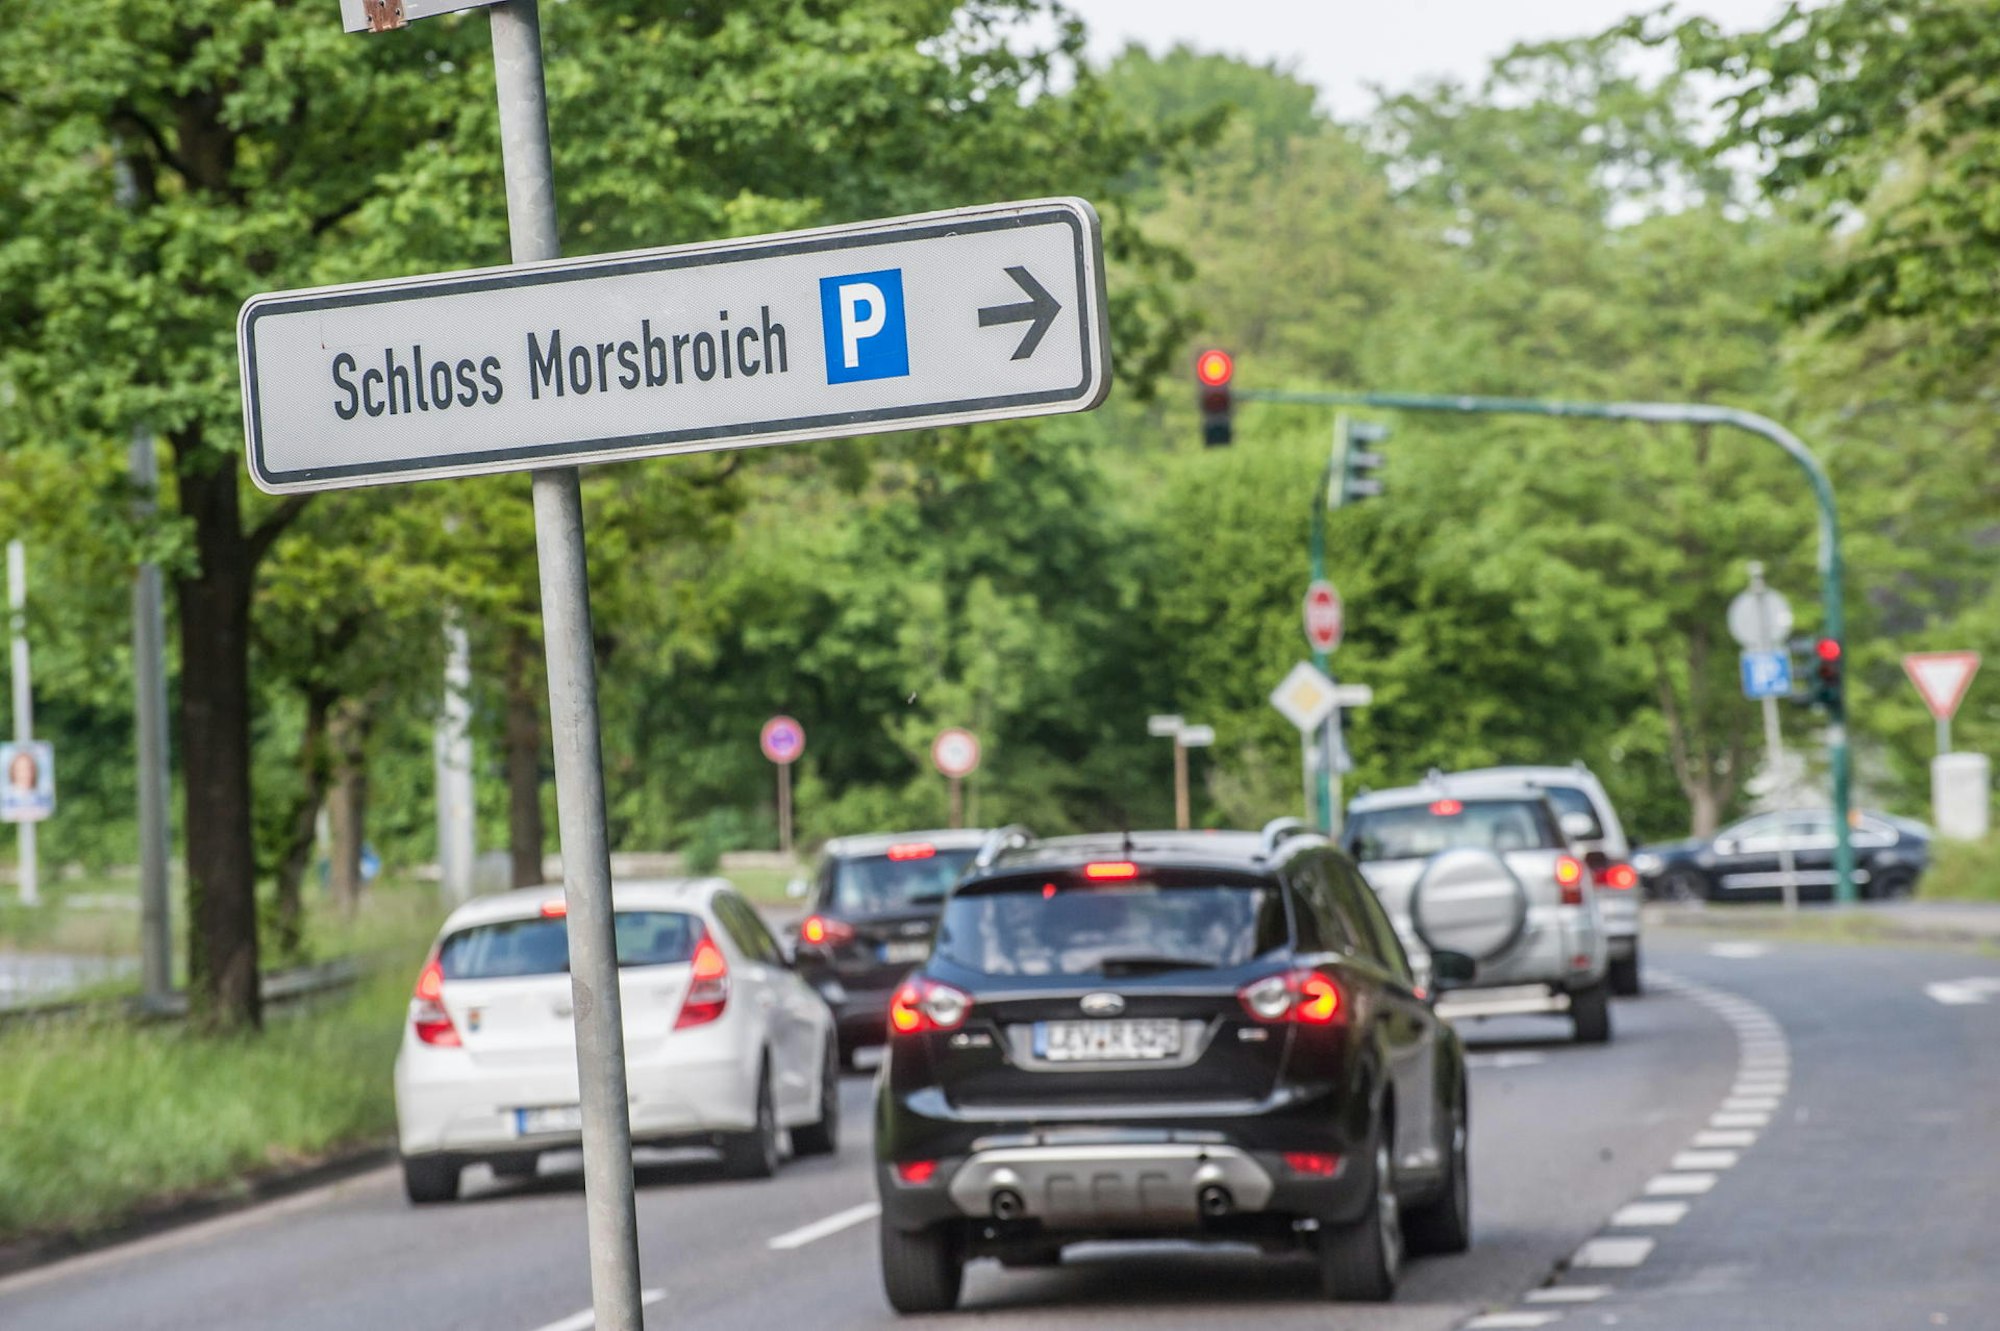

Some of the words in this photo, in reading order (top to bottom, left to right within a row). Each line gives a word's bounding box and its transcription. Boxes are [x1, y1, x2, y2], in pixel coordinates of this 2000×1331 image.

[332, 344, 504, 421] Schloss
[527, 305, 788, 400] Morsbroich
[839, 282, 886, 368] P
